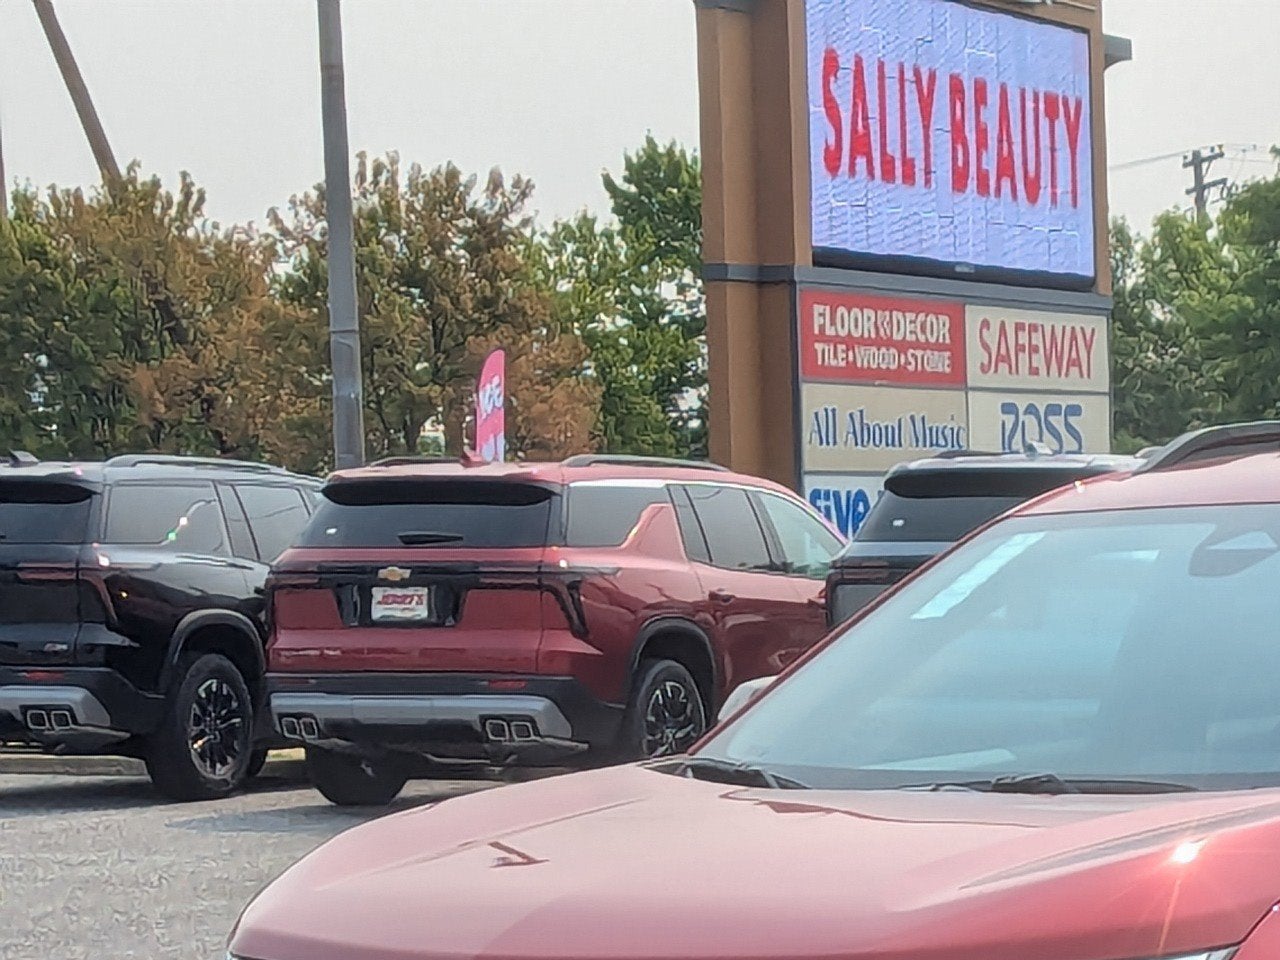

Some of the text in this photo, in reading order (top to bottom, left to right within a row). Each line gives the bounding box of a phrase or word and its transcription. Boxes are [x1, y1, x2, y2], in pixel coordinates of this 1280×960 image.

[821, 47, 1083, 210] SALLY BEAUTY
[812, 303, 876, 340] FLOOR
[892, 310, 951, 345] DECOR
[813, 342, 952, 374] TILE WOOD STONE
[977, 317, 1096, 380] SAFEWAY
[808, 407, 967, 451] All About Music
